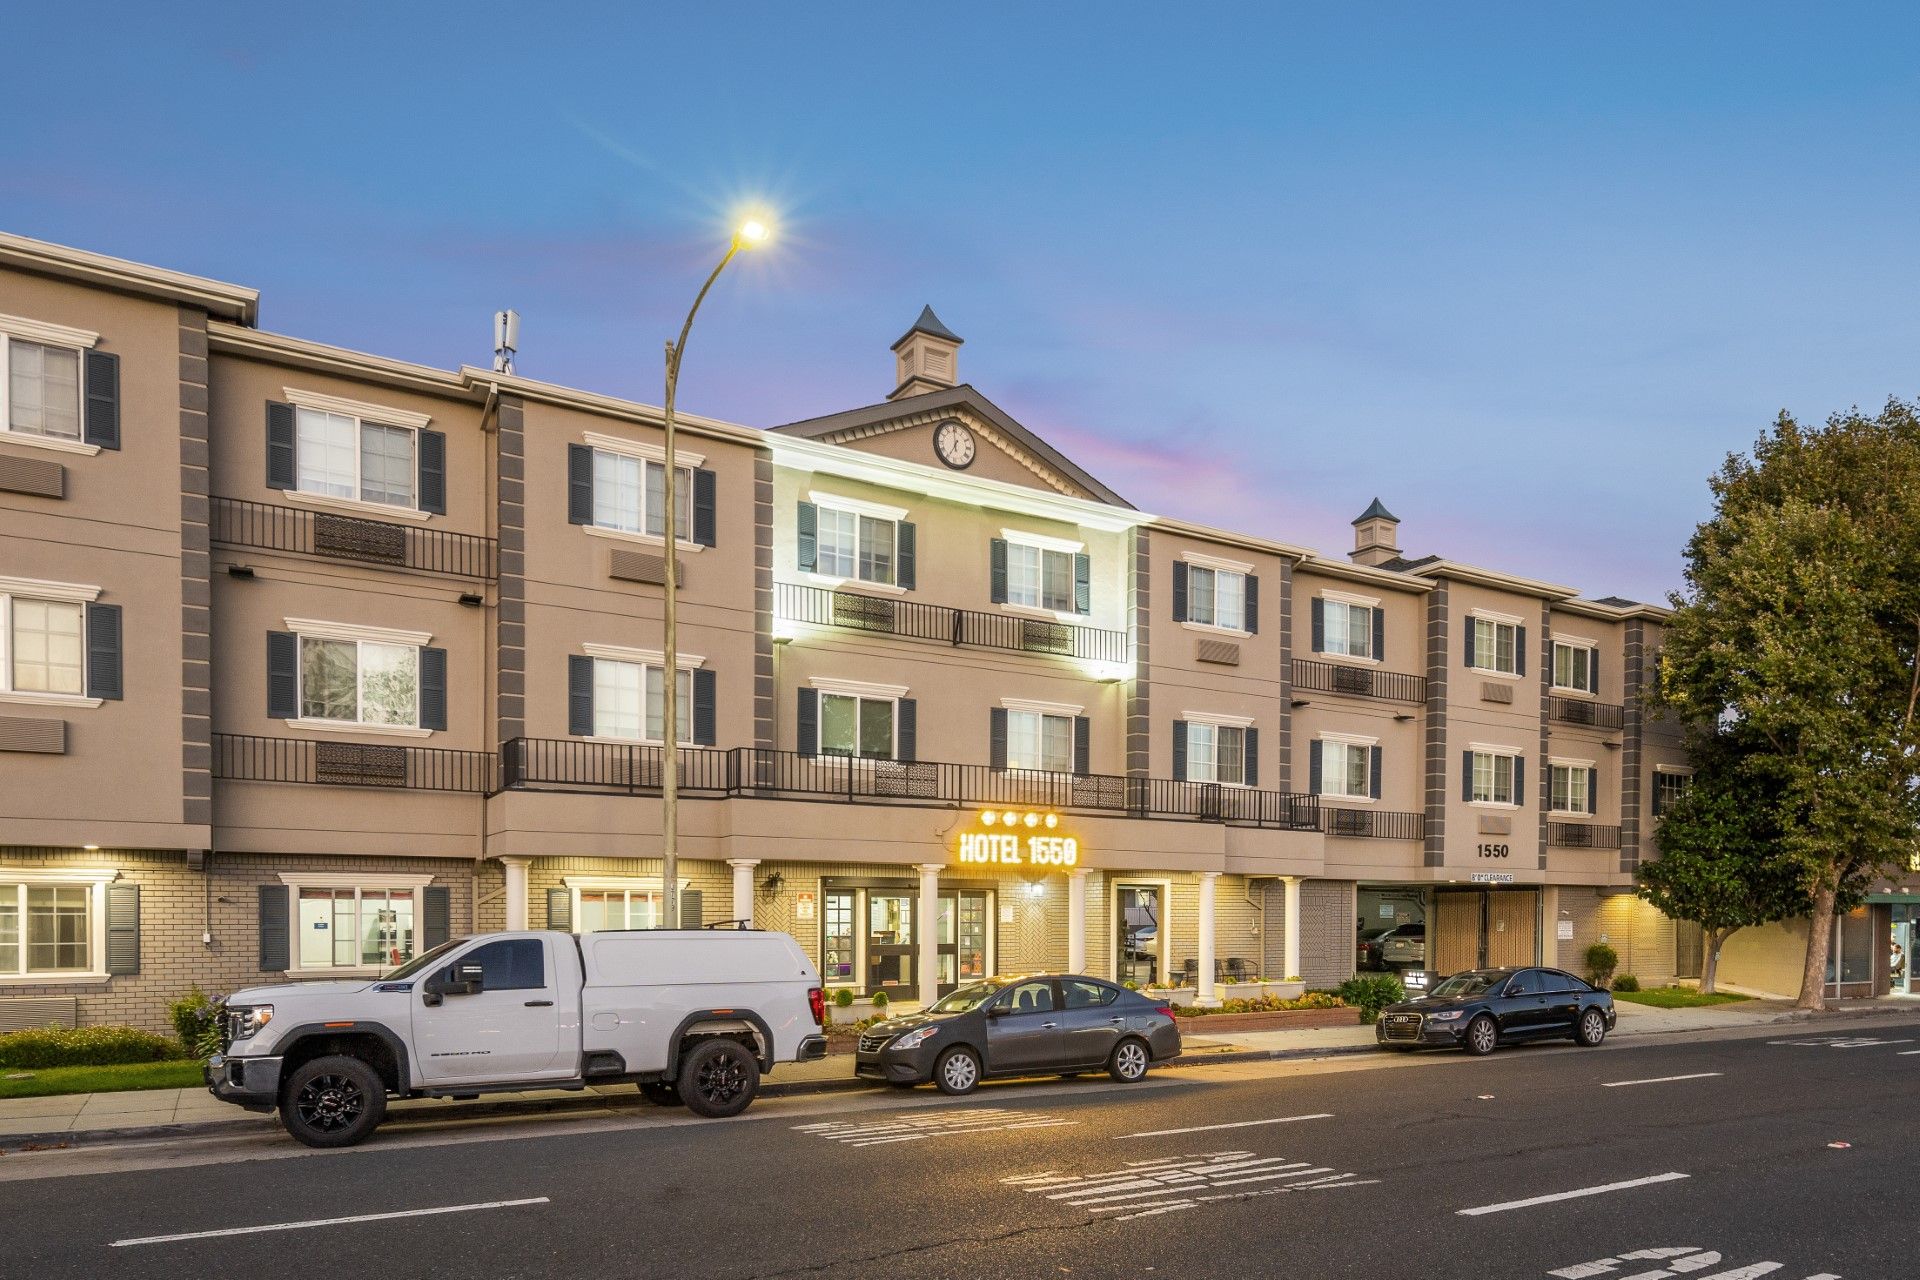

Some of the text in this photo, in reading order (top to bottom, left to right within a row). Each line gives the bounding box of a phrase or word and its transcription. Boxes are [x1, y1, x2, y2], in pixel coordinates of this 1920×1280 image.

[960, 834, 1077, 866] HOTEL 1550
[1477, 844, 1509, 858] 1550
[1484, 874, 1513, 882] CLEARANCE
